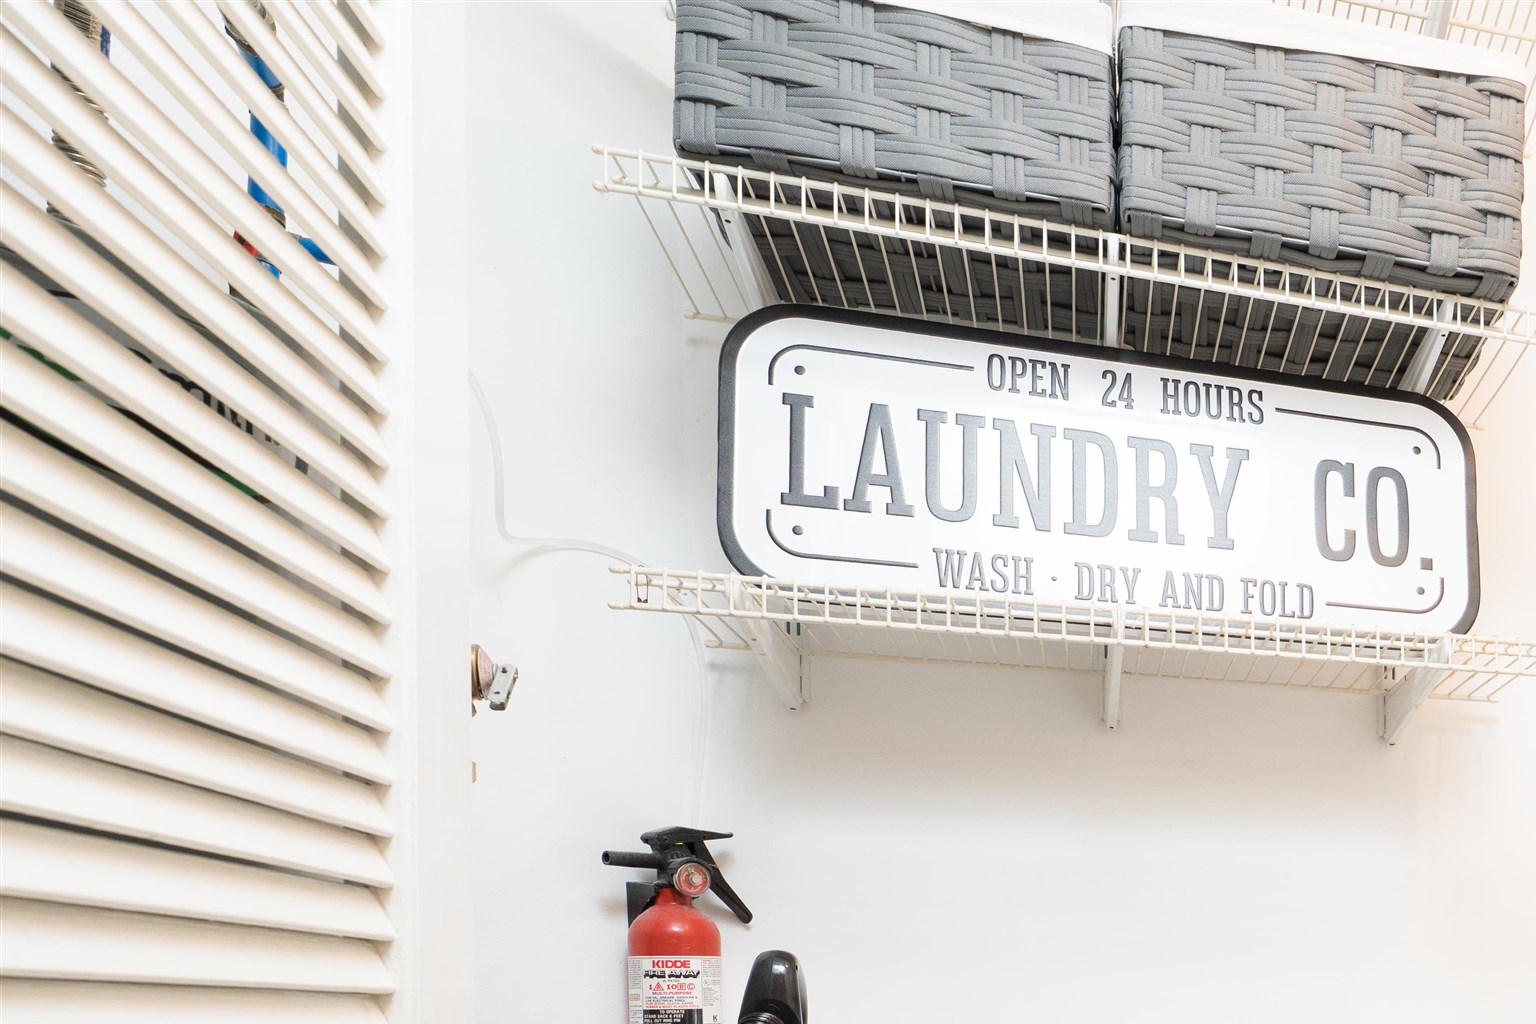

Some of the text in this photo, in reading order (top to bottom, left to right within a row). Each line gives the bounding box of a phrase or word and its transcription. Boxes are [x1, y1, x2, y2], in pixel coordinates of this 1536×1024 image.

[985, 353, 1266, 426] OPEN 24 HOURS
[780, 392, 1435, 572] LAUNDRY CO.
[933, 547, 1317, 621] WASH DRY AND FOLD
[652, 960, 691, 969] KIDDE
